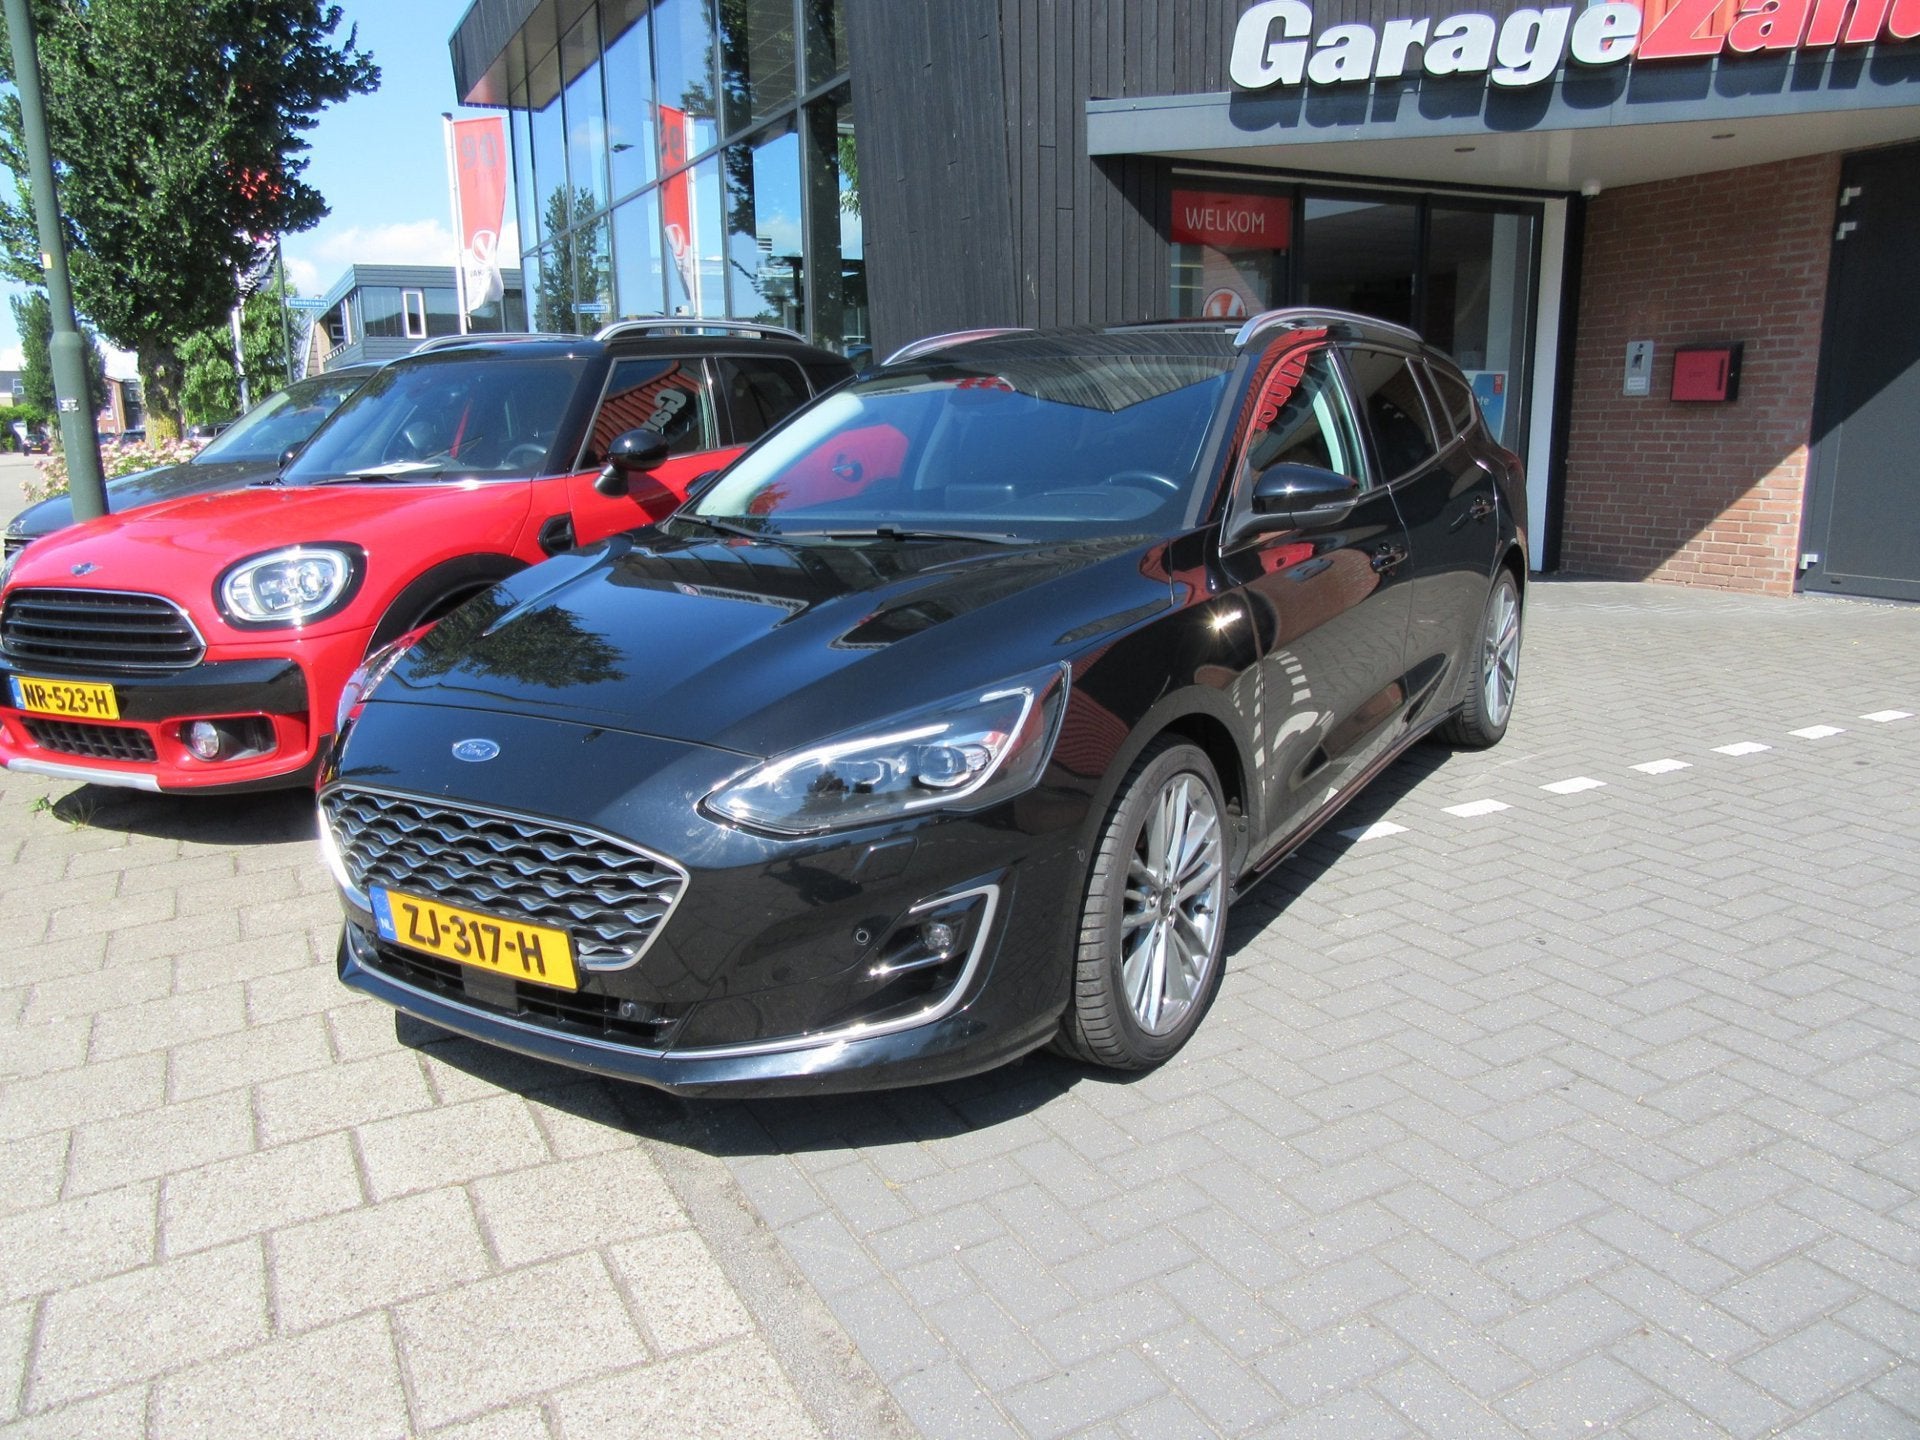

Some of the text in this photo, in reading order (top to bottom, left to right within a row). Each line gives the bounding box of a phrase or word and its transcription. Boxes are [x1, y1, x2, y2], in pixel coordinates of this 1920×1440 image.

[1229, 0, 1920, 89] Garage Zan
[461, 132, 497, 170] 90
[1185, 207, 1265, 234] WELKOM
[23, 683, 110, 715] NR-523-H
[380, 917, 393, 931] NL
[402, 902, 546, 976] ZJ-317-H
